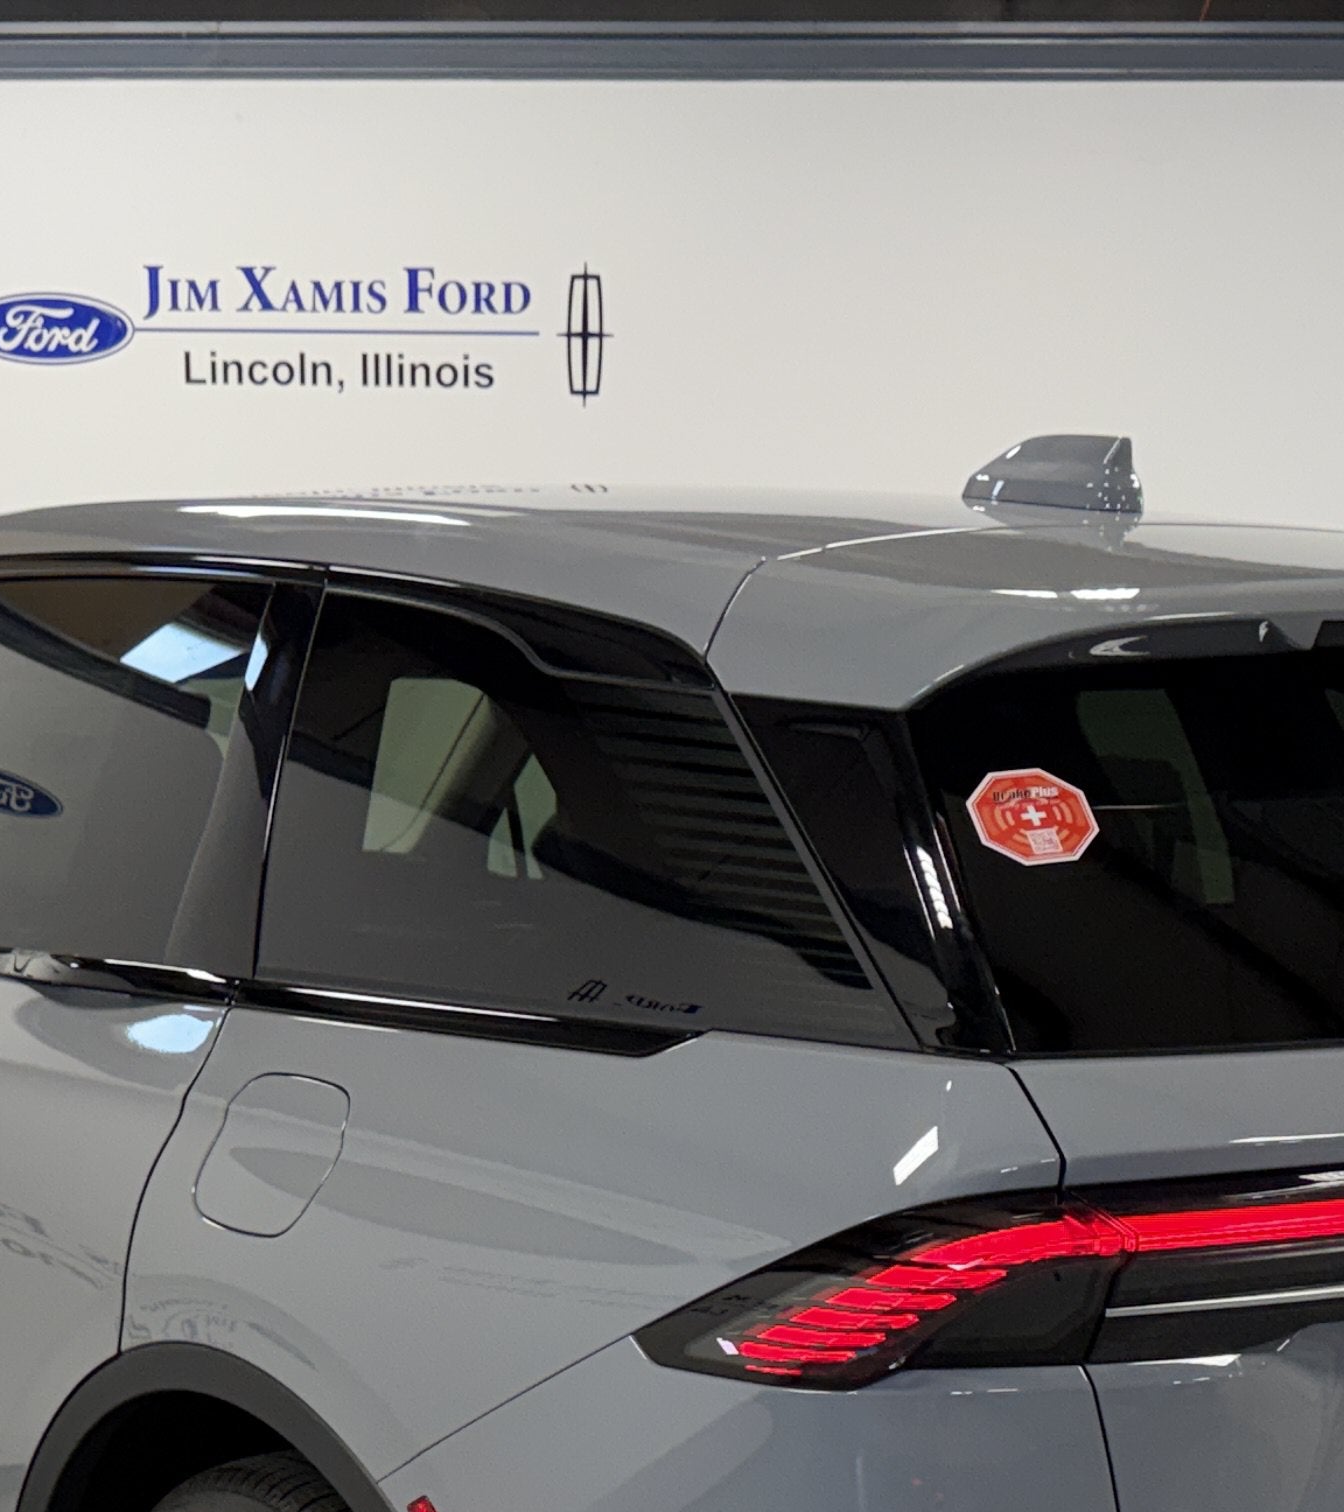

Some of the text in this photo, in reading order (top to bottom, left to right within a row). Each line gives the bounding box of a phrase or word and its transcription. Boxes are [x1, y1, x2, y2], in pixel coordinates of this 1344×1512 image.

[143, 265, 531, 319] JIM XAMIS FORD
[184, 350, 494, 393] Lincoln, Illinois
